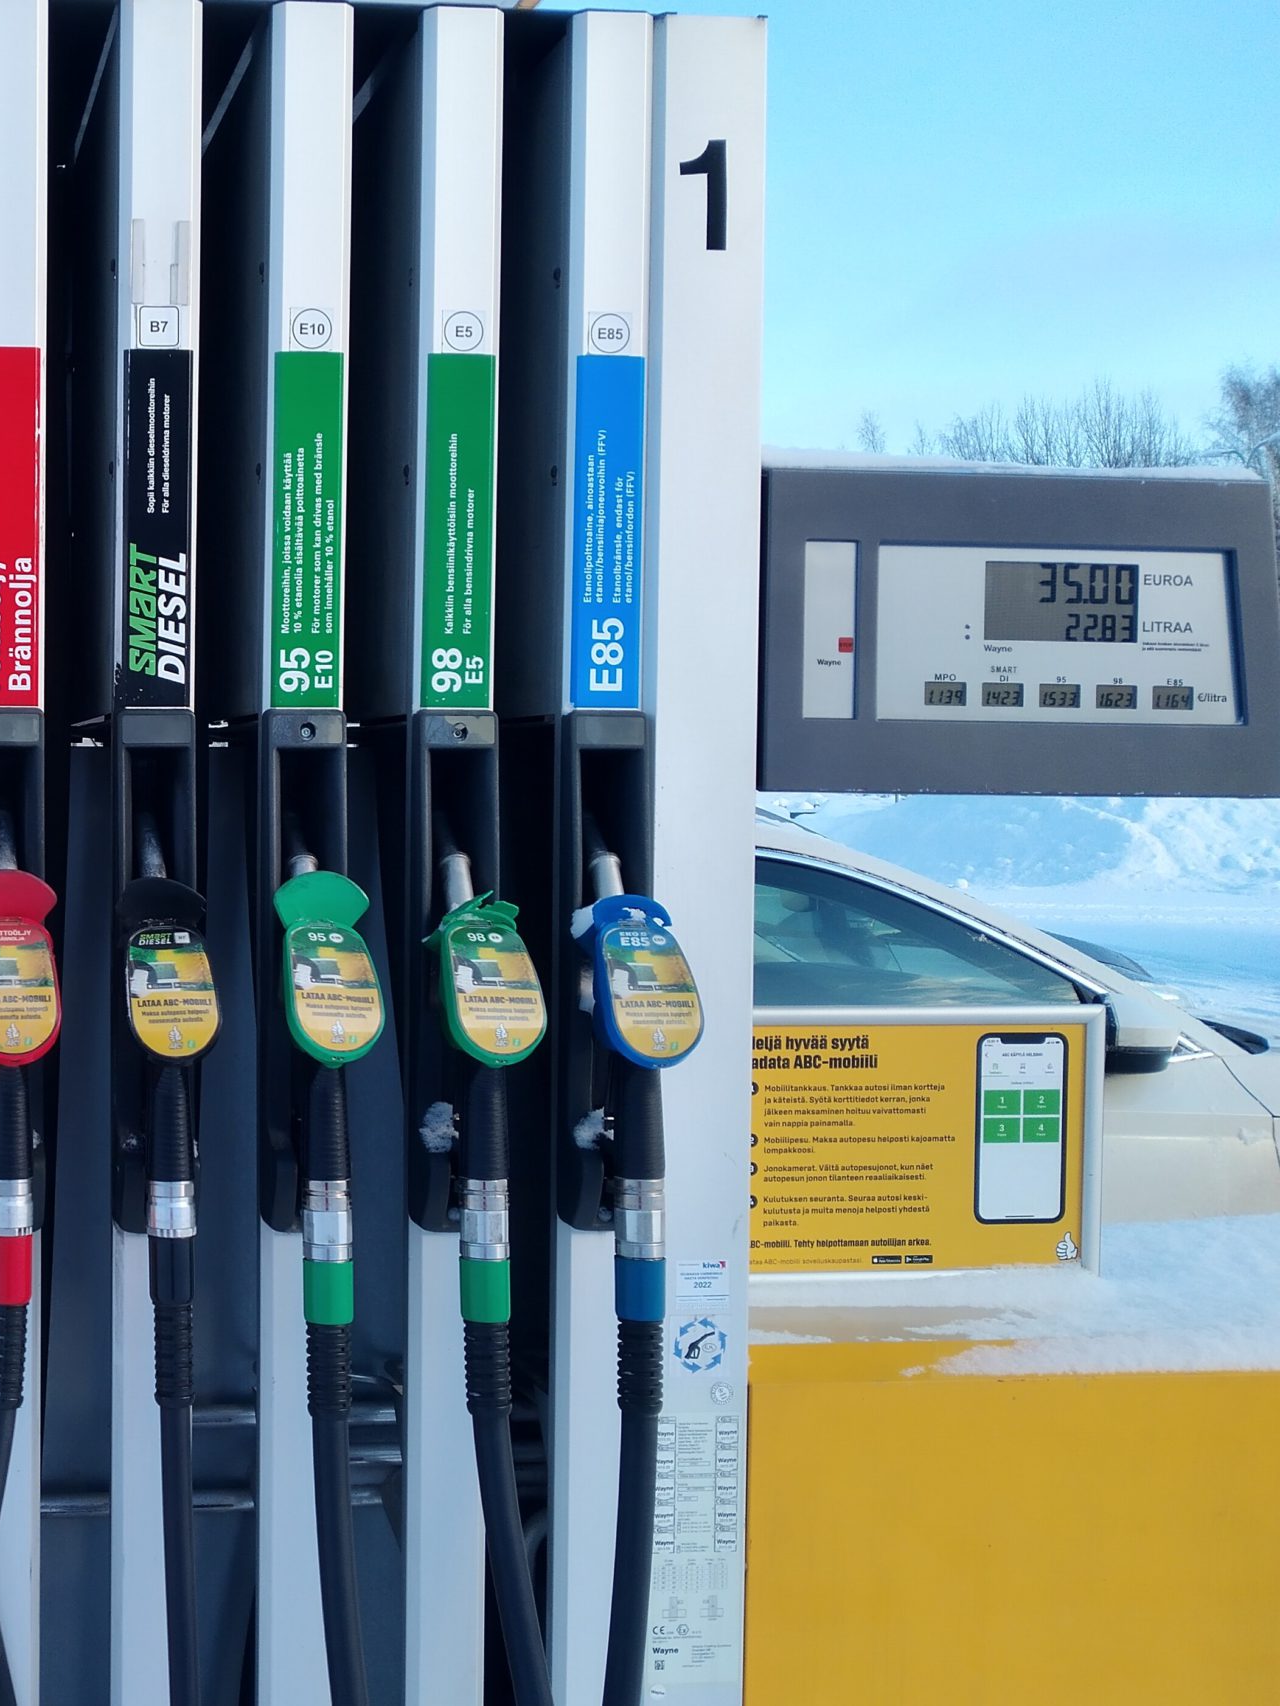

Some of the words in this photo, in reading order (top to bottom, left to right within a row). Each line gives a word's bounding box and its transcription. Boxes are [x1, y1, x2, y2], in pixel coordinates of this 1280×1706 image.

[679, 139, 727, 251] 1
[149, 319, 169, 334] B7
[298, 321, 326, 337] E10
[454, 323, 474, 338] E5
[596, 326, 625, 341] E85
[148, 378, 156, 456] dieselmoottoreihin
[162, 430, 170, 480] dieseldrivna
[314, 433, 323, 469] bränsle
[598, 429, 607, 456] (FFV)
[147, 458, 155, 490] kaikkiin
[283, 453, 293, 489] käyttää
[296, 448, 305, 512] polttoainetta
[449, 434, 457, 498] moottoreihin
[162, 482, 170, 497] alla
[314, 473, 322, 494] med
[585, 455, 595, 509] ainoastaan
[615, 477, 623, 491] för
[626, 471, 635, 497] (FFV)
[147, 492, 156, 513] Sopii
[283, 493, 291, 532] voidaan
[313, 498, 321, 527] drivas
[326, 500, 334, 531] etanol
[466, 488, 474, 528] motorer
[614, 494, 623, 528] endast
[295, 515, 304, 564] sisältävää
[313, 530, 321, 547] kan
[325, 534, 334, 543] %
[446, 501, 457, 592] bensiinikäyttöisiin
[595, 459, 606, 603] etanoli/bensiiniajoneuvoihin
[282, 535, 292, 564] joissa
[325, 546, 333, 557] 10
[464, 532, 474, 595] bensindrivna
[584, 513, 595, 603] Etanolipolttoaine,
[625, 500, 634, 603] etanol/bensinfordon
[613, 531, 623, 603] Etanolbränsle,
[295, 568, 303, 607] etanolia
[313, 576, 321, 614] motorer
[325, 560, 333, 609] innehåller
[1039, 563, 1134, 604] 35.00
[1143, 574, 1193, 586] EUROA
[129, 543, 157, 676] SMART
[281, 566, 291, 633] Moottoreihin,
[294, 611, 302, 619] %
[445, 595, 454, 634] Kaikkiin
[463, 598, 472, 615] alla
[8, 558, 36, 691] Brännolja
[158, 552, 186, 684] DIESEL
[294, 623, 302, 633] 10
[312, 618, 320, 633] För
[463, 618, 471, 634] För
[1142, 621, 1193, 633] LITRAA
[589, 618, 624, 691] E85
[817, 659, 841, 667] Wayne
[984, 645, 1012, 653] Wayne
[279, 648, 310, 692] 95
[315, 650, 333, 688] E10
[431, 648, 462, 693] 98
[465, 656, 483, 684] E5
[1198, 693, 1227, 702] €/litra
[308, 933, 326, 941] 95
[467, 933, 486, 941] 98
[621, 937, 650, 946] E85
[786, 1035, 827, 1051] hyvää
[831, 1035, 869, 1051] syytä
[794, 1055, 878, 1069] ABC-mobiili
[914, 1084, 945, 1092] kortteja
